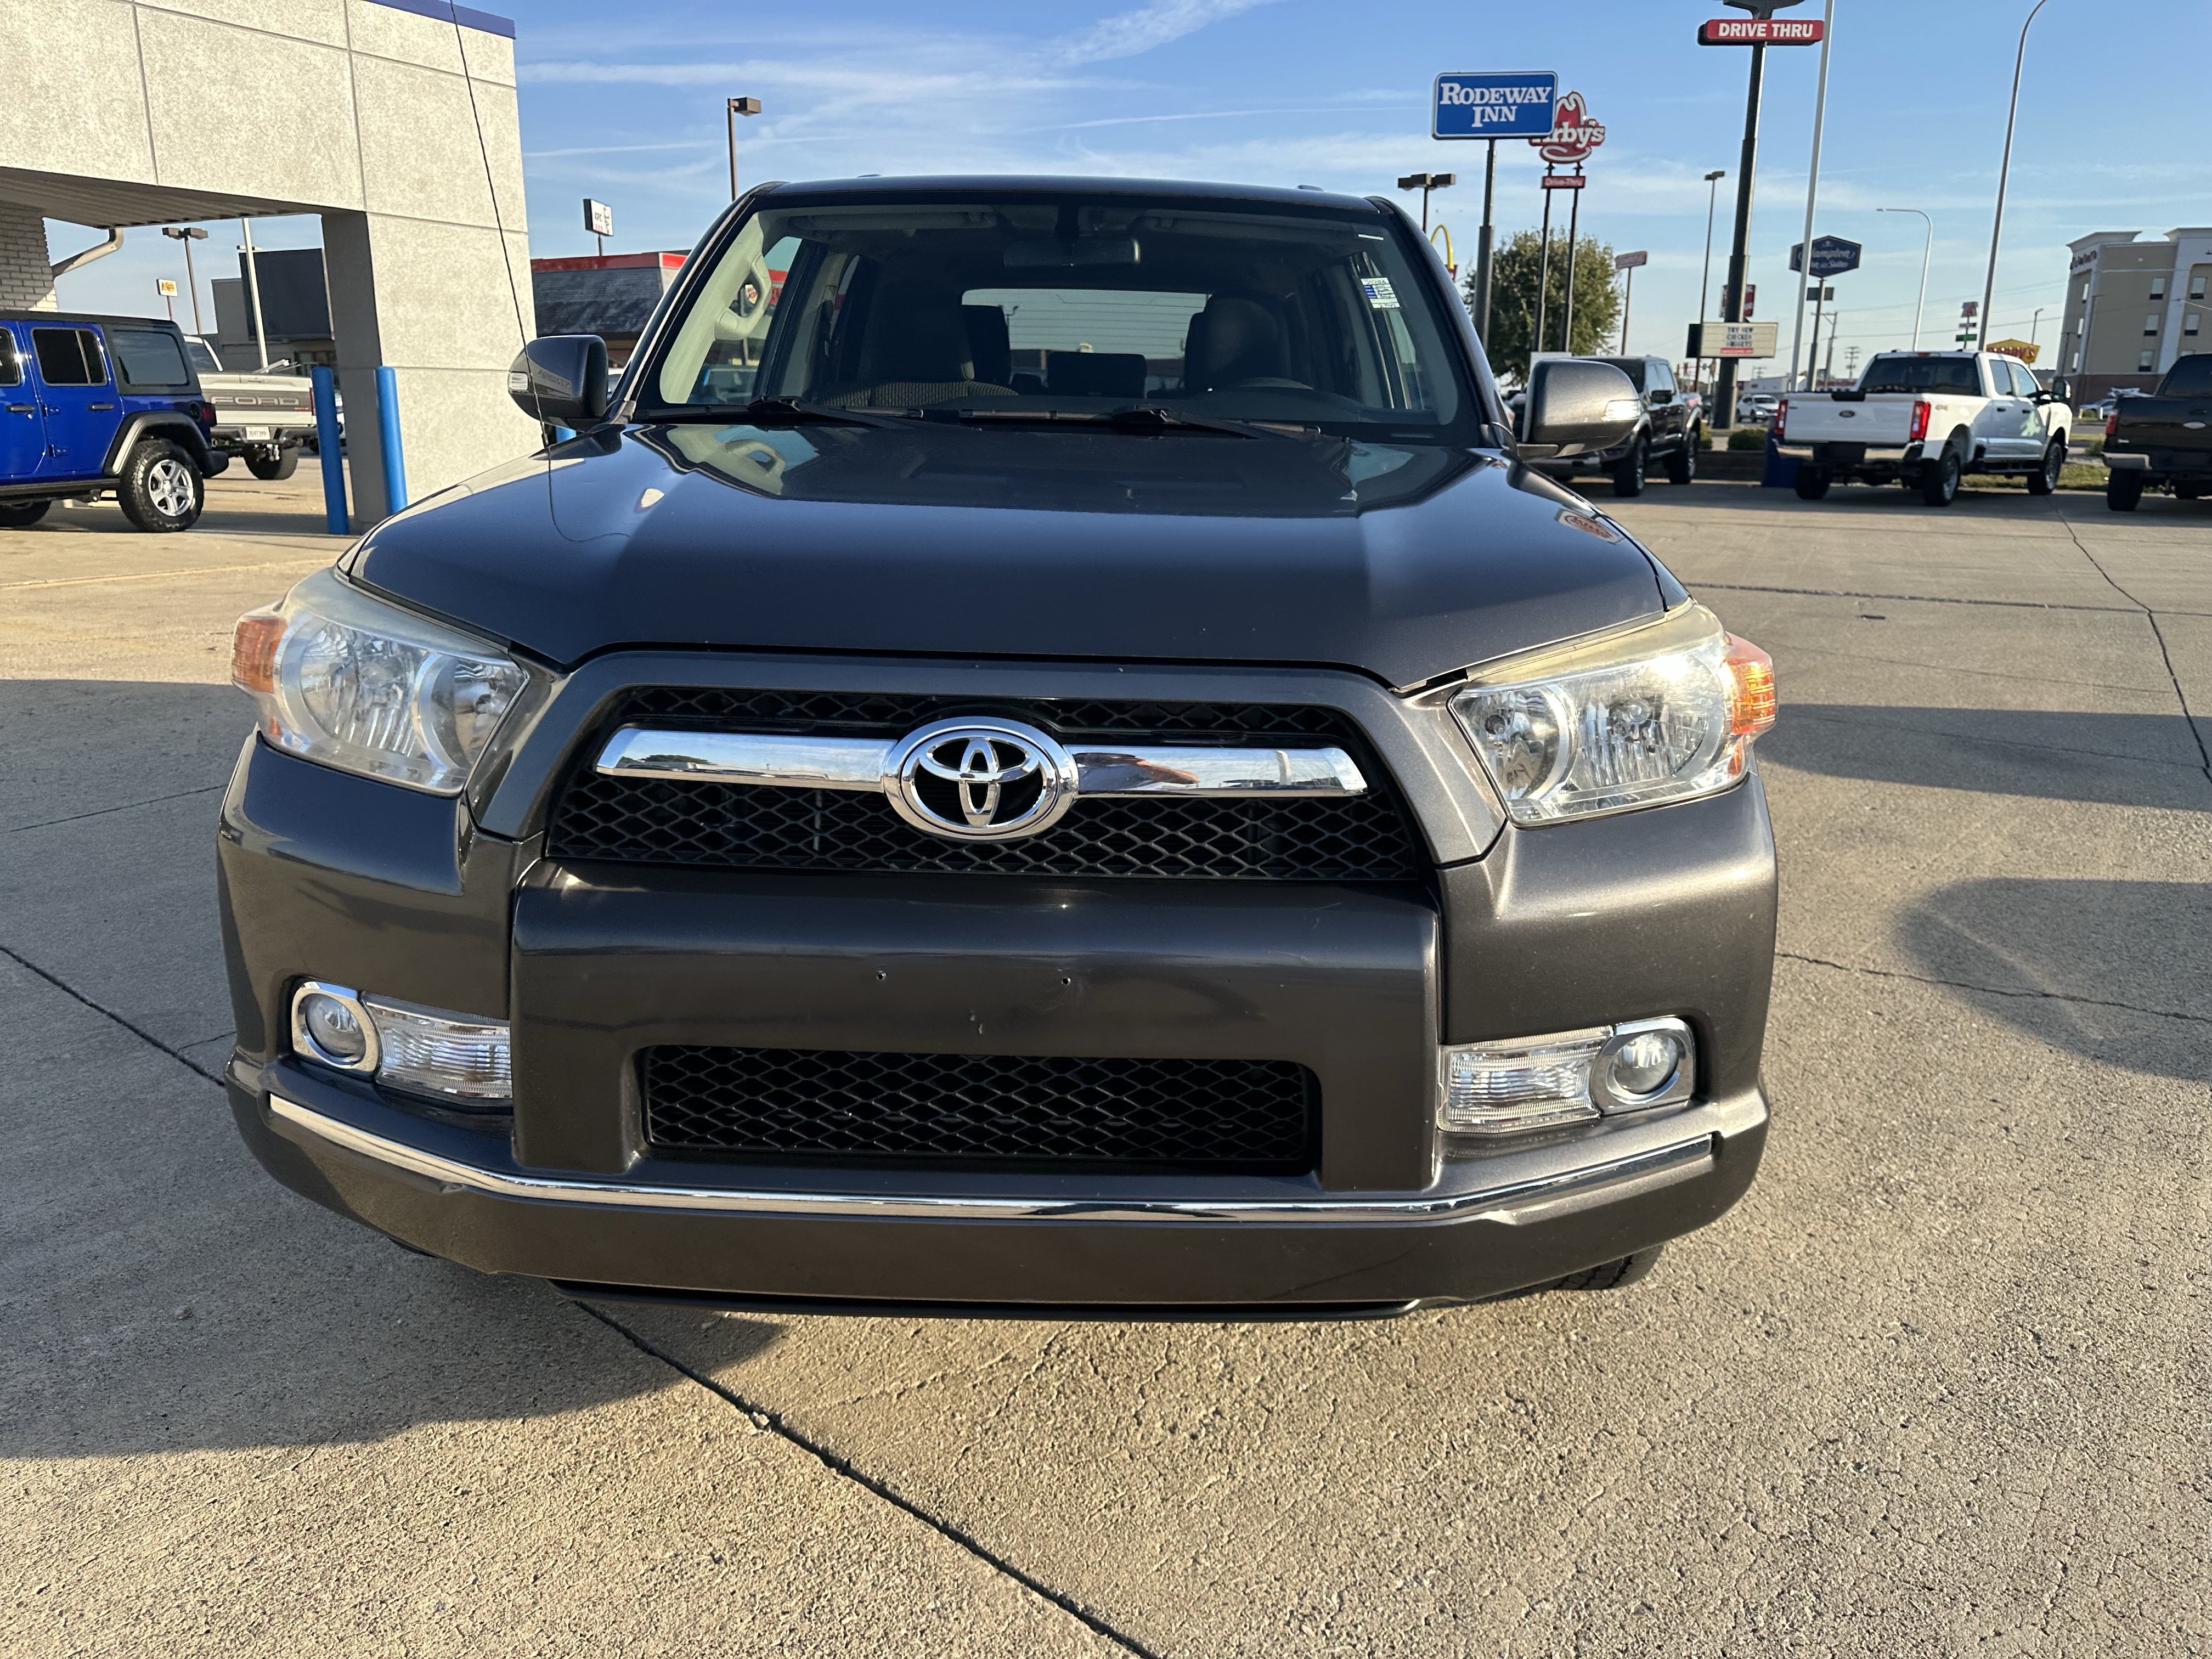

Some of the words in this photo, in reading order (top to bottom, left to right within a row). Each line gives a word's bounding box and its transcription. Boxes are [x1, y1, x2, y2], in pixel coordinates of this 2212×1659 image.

[1718, 22, 1767, 37] DRIVE
[1771, 23, 1813, 37] THRU
[1440, 82, 1552, 104] RODEWAY
[1471, 105, 1517, 127] INN
[1531, 120, 1605, 149] rby's
[211, 397, 300, 405] FORD
